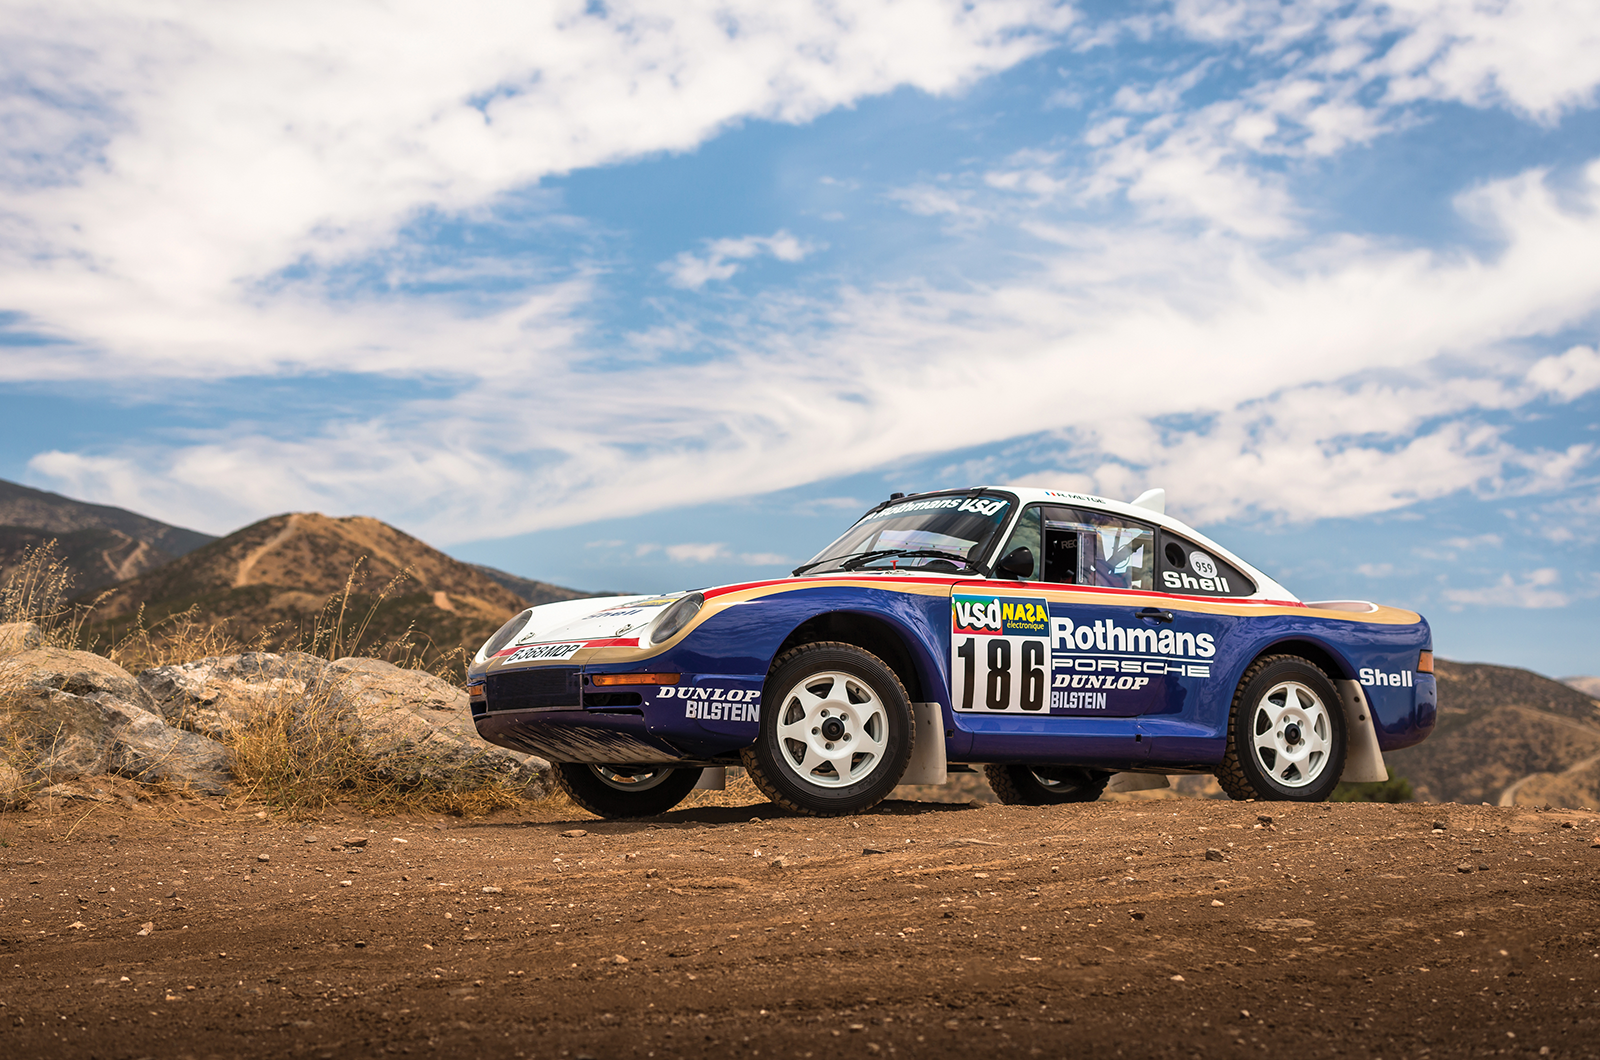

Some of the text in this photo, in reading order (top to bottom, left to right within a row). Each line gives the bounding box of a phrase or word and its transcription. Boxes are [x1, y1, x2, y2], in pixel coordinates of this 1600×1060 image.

[873, 499, 962, 519] Rothmans
[1195, 561, 1213, 574] 959
[1162, 570, 1231, 593] Shell
[955, 598, 1001, 630] vsd
[1006, 620, 1045, 632] électronique
[1050, 616, 1216, 657] Rothmans
[957, 637, 1045, 711] 186
[1052, 658, 1210, 678] PORSCHE
[1359, 667, 1413, 687] Shell
[1052, 674, 1149, 690] DUNLOP
[656, 686, 761, 702] DUNLOP
[1050, 691, 1107, 710] BILSTEIN
[685, 700, 760, 722] BILSTEIN
